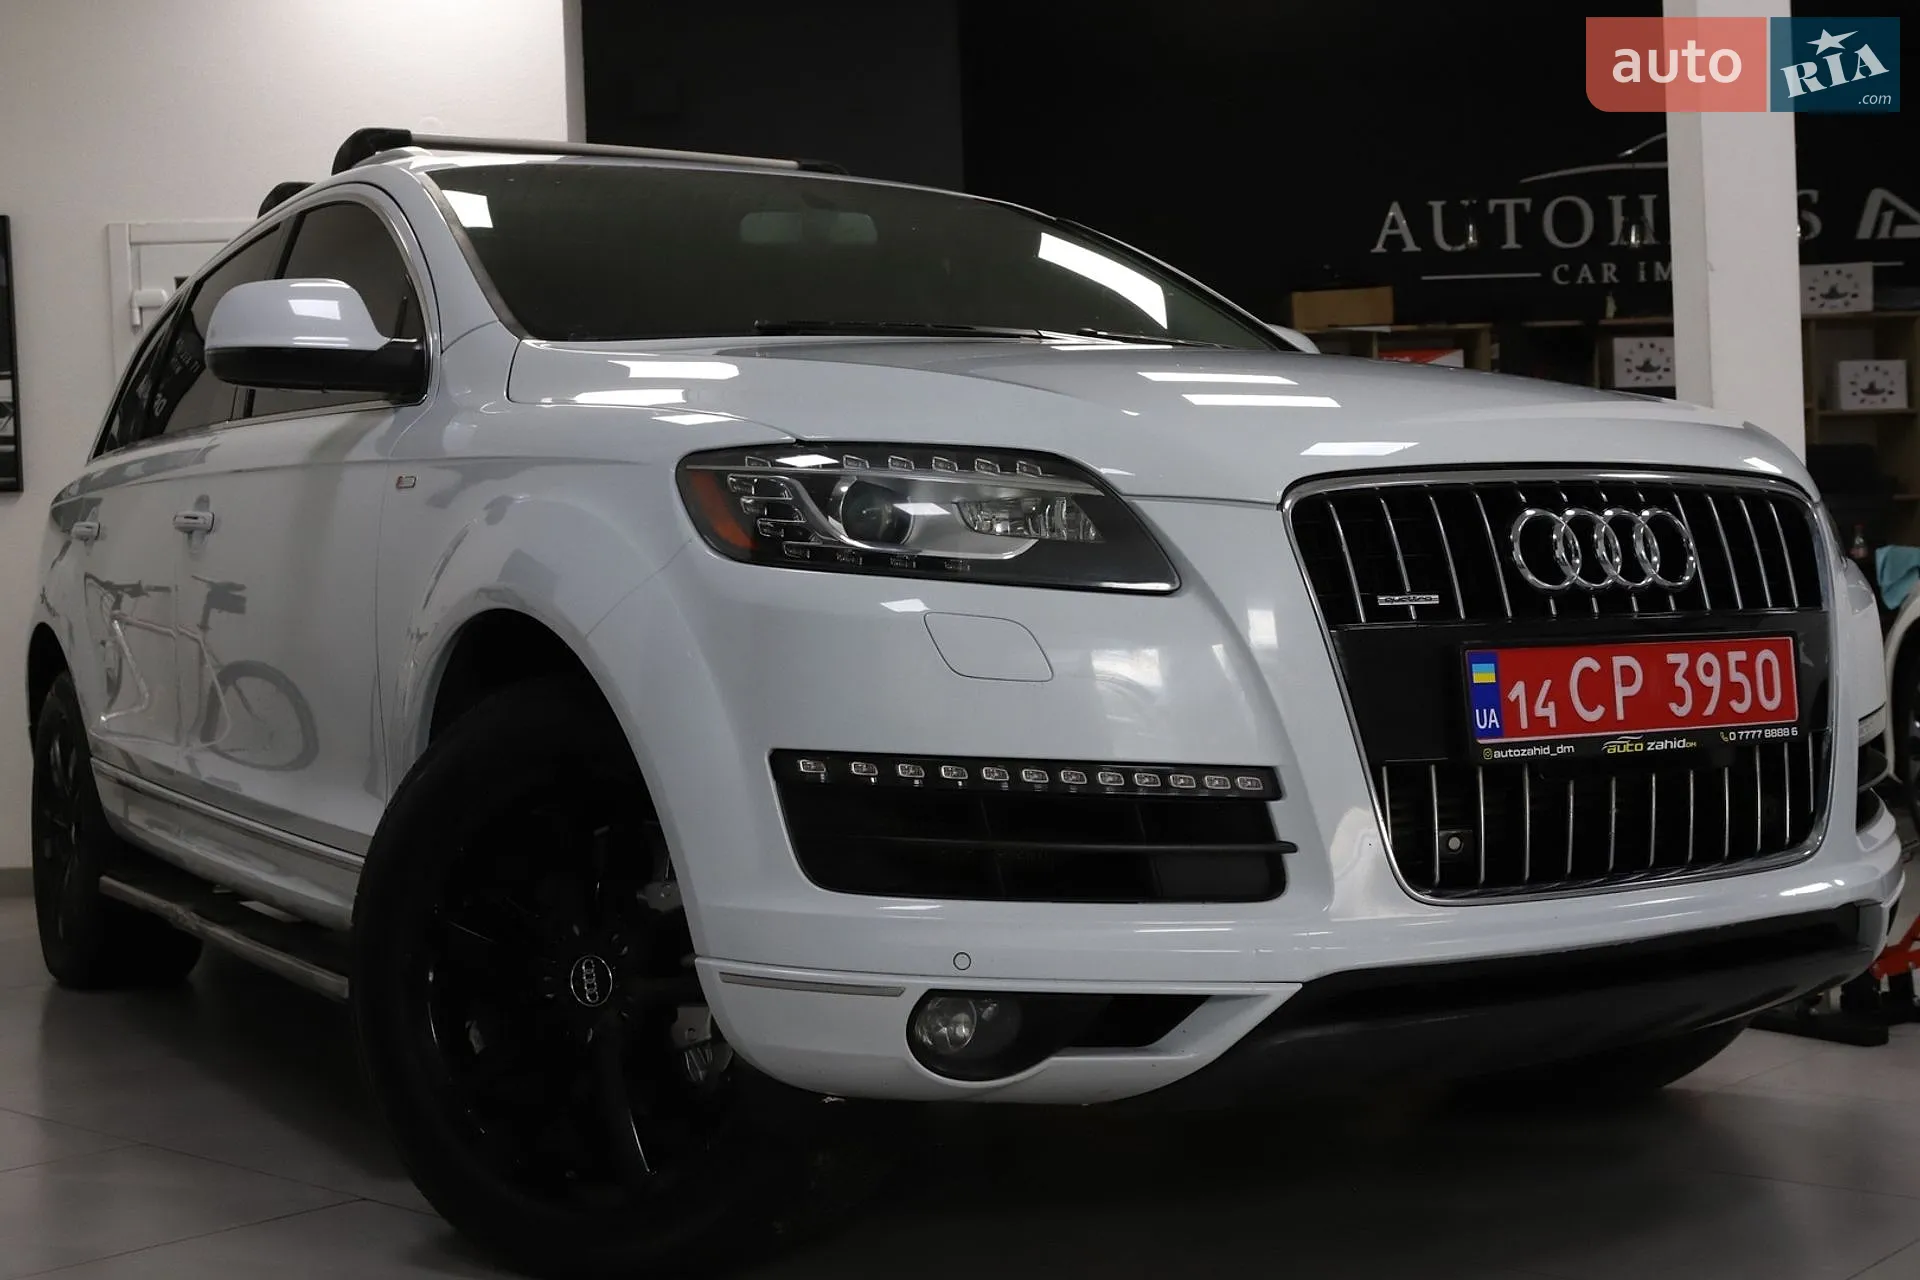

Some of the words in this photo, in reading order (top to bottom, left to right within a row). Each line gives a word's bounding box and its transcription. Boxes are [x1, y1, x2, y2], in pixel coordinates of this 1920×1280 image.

[1370, 188, 1822, 252] AUTOHS
[1552, 262, 1619, 285] CAR
[1639, 261, 1672, 282] IM
[1507, 679, 1557, 729] 14
[1569, 655, 1644, 722] CP
[1666, 649, 1783, 717] 3950
[1475, 708, 1500, 729] UA
[1493, 744, 1575, 758] autozahid_dm
[1607, 741, 1644, 754] auto
